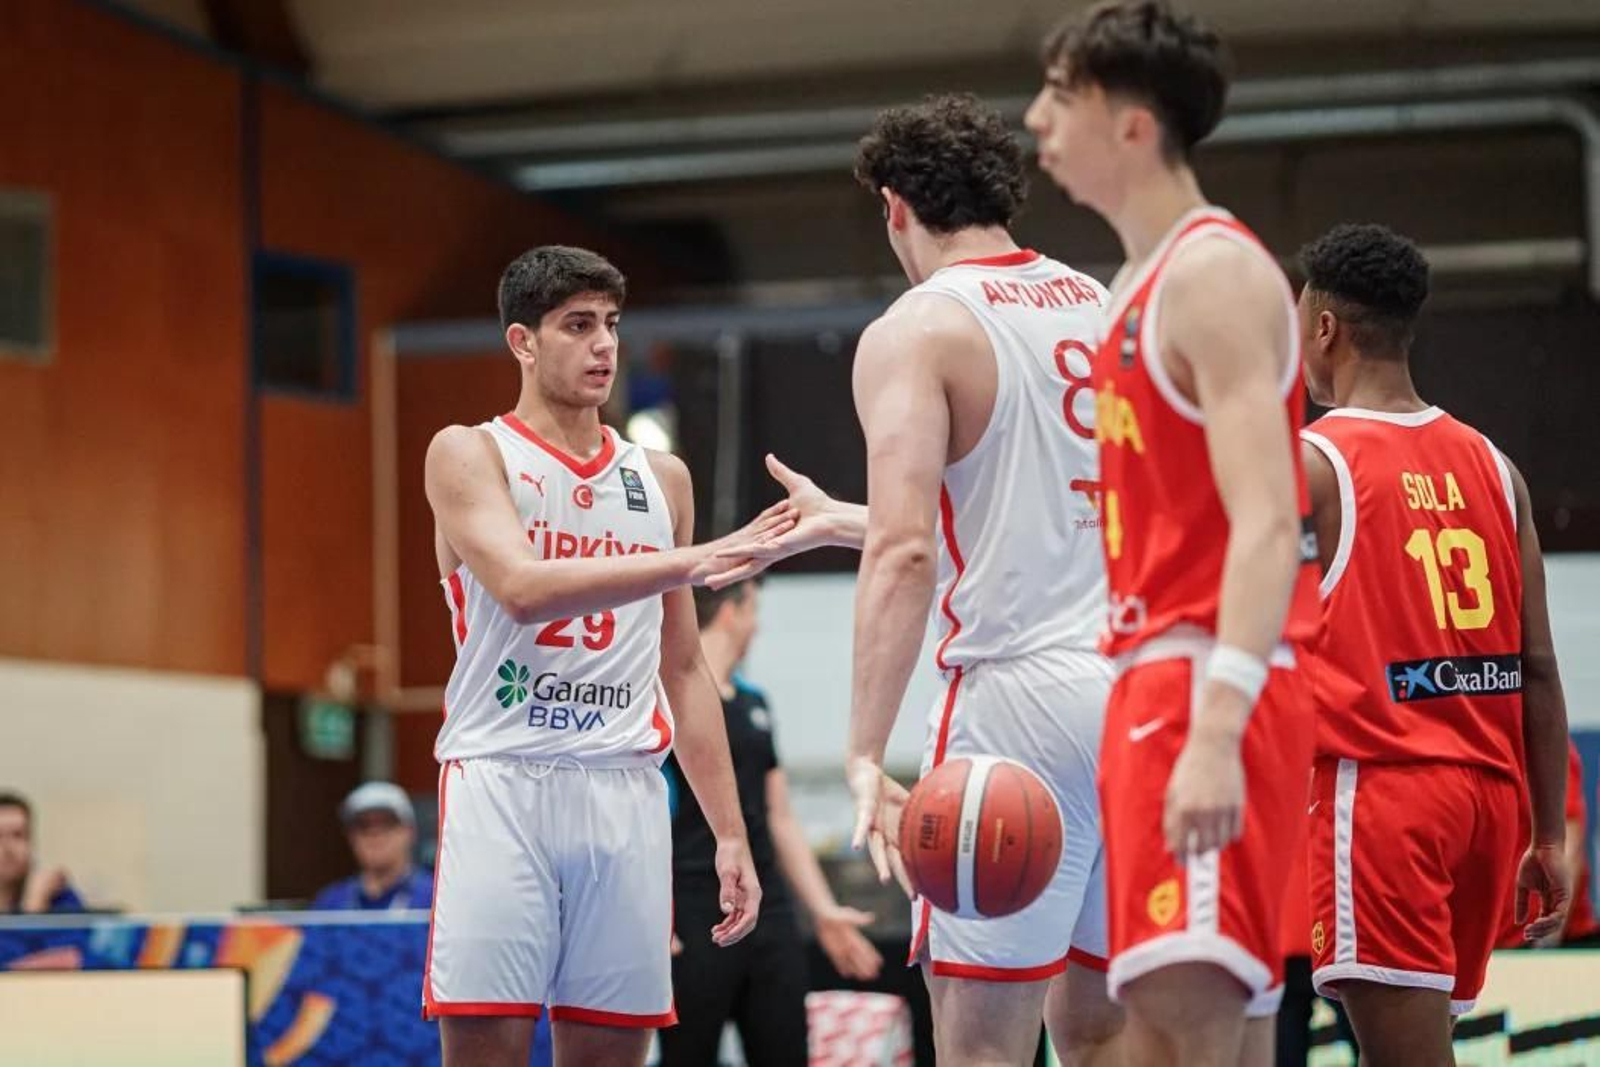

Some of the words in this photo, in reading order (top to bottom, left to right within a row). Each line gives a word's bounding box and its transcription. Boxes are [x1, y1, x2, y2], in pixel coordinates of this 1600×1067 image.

[1053, 339, 1098, 440] 8
[1402, 472, 1466, 511] SOLA
[1404, 528, 1495, 630] 13
[534, 609, 616, 651] 29
[532, 672, 632, 709] Garanti
[528, 706, 606, 732] BBVA
